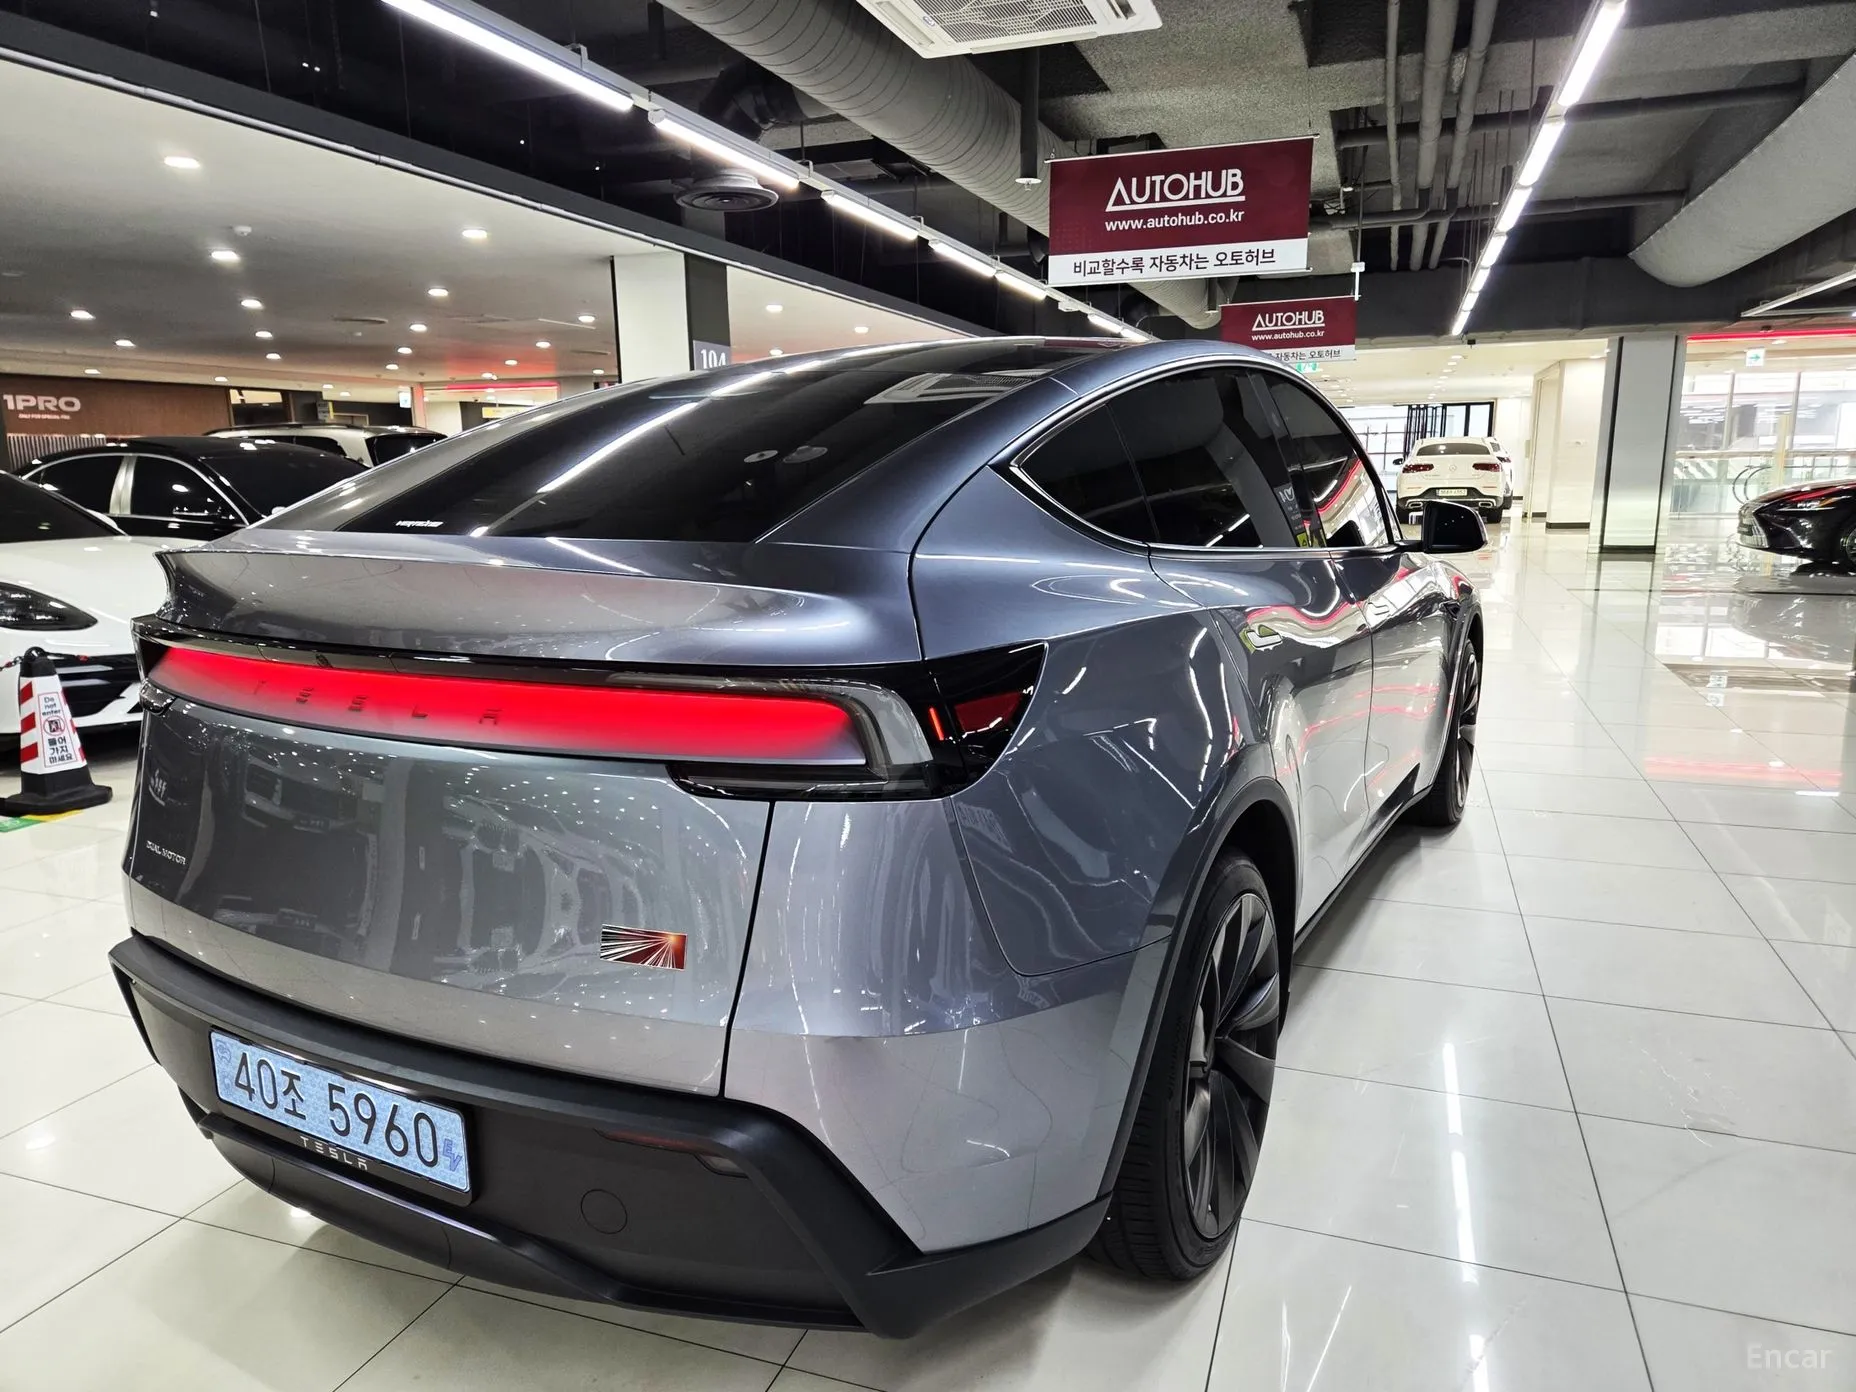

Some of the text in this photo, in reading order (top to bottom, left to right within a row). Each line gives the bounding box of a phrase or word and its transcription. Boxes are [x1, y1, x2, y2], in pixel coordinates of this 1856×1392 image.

[1105, 168, 1246, 212] AUTOHUB
[1105, 208, 1245, 232] www.autohub.co.kr
[1073, 248, 1276, 277] 비교할수록 자동차는 오토허브
[1252, 309, 1325, 331] AUTOHUB
[1251, 330, 1325, 341] www.autohub.co.kr
[1275, 351, 1307, 361] 자동차는
[1308, 349, 1341, 359] 오토허브
[254, 680, 502, 726] TESLA
[49, 753, 72, 764] 마세요
[50, 746, 68, 755] 가지
[161, 847, 186, 865] MOTOR
[234, 1052, 439, 1169] 40조 5960
[300, 1135, 368, 1172] TESLA
[442, 1138, 463, 1173] EV
